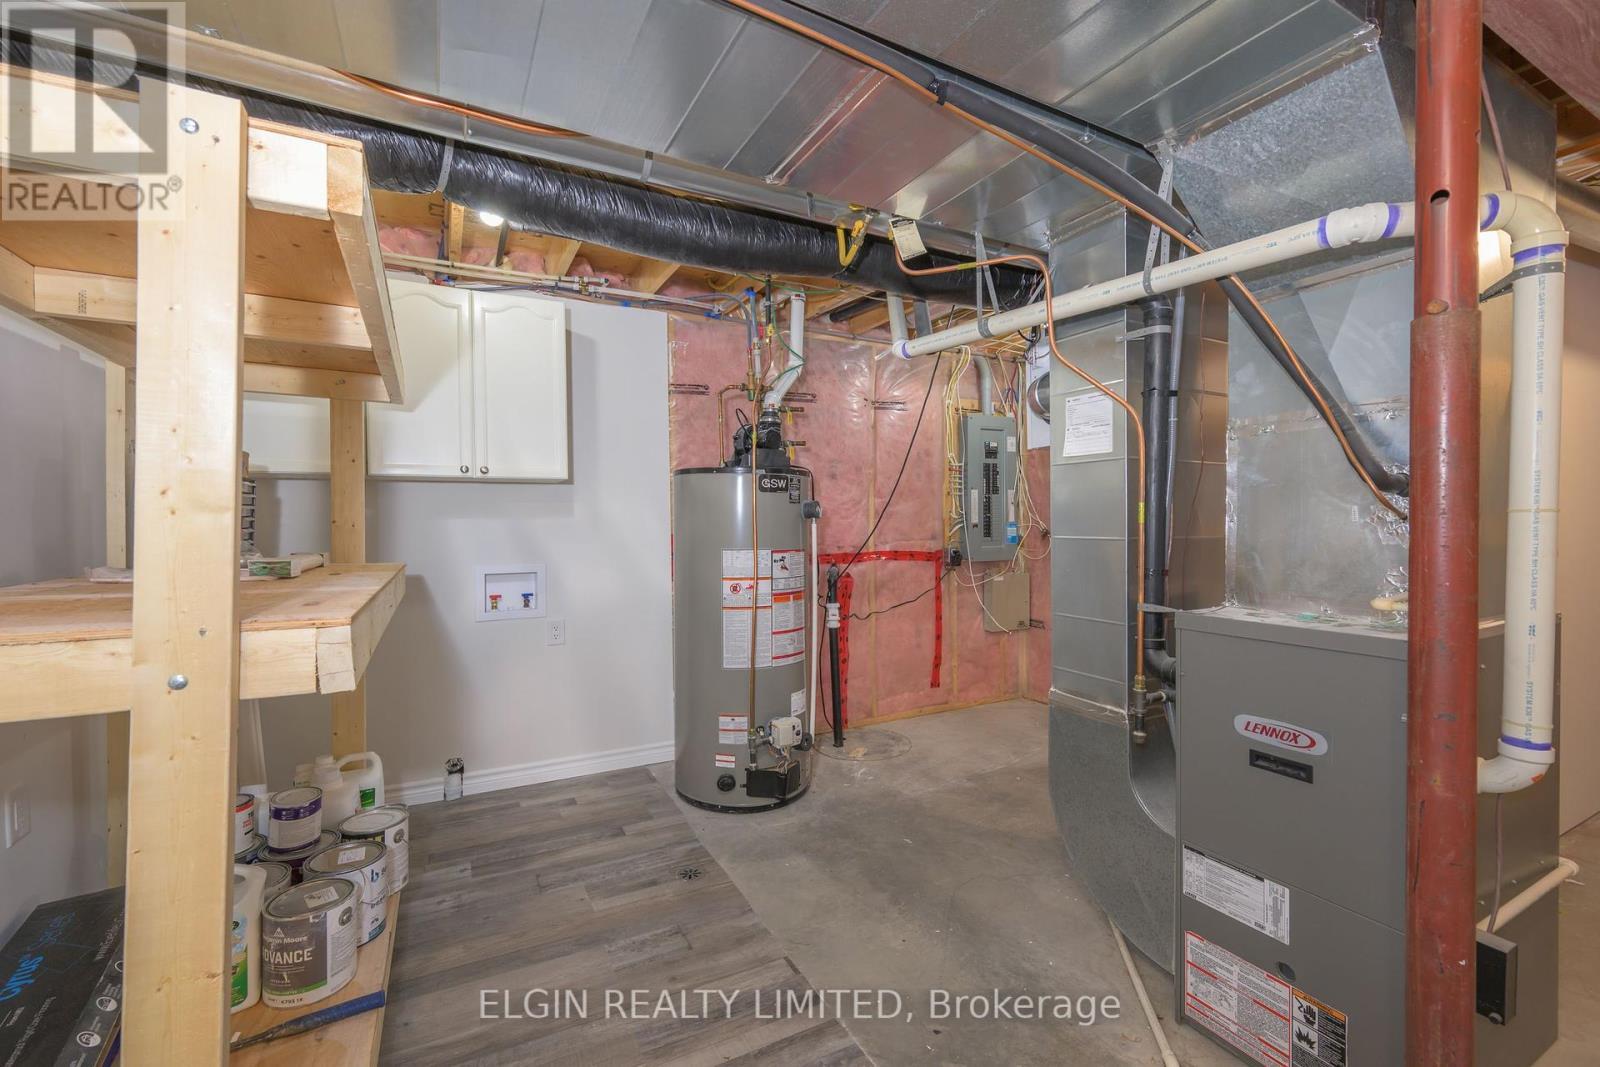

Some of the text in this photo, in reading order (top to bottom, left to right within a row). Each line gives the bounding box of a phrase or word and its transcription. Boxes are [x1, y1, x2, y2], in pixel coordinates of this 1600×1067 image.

[761, 478, 787, 488] GSW
[1243, 720, 1301, 745] LENNOX
[264, 947, 313, 965] DVANCE
